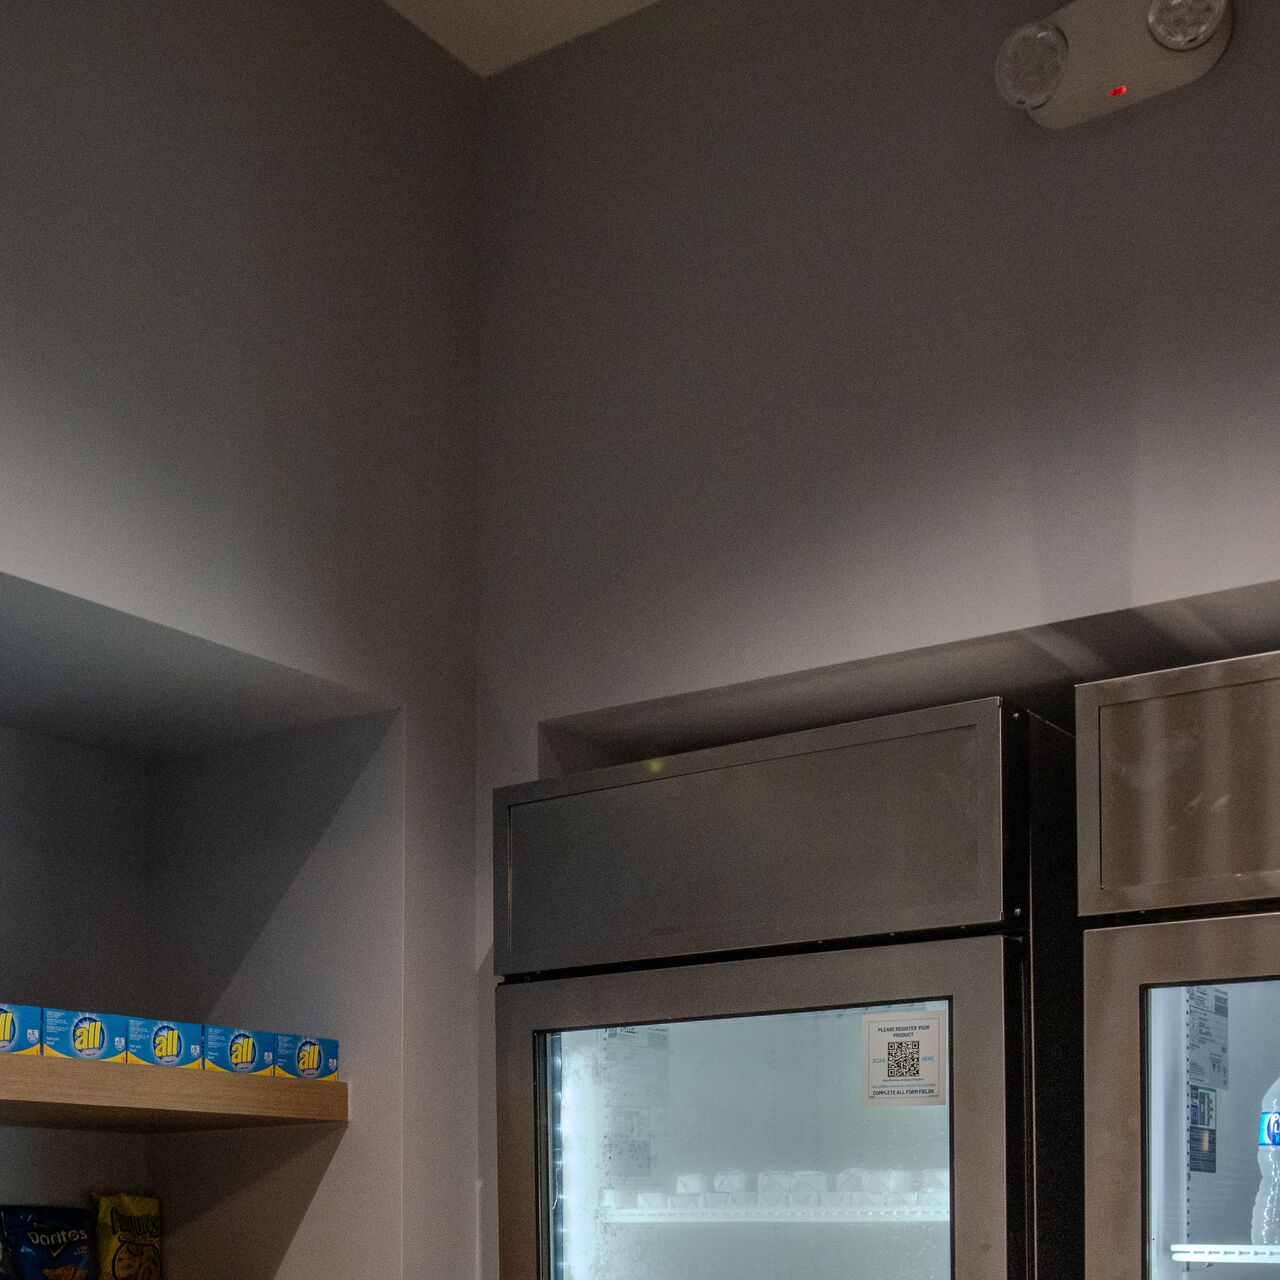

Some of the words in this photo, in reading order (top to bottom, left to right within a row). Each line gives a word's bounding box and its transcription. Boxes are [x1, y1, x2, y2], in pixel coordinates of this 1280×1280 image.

[73, 1021, 102, 1050] all
[154, 1029, 179, 1057] all
[230, 1037, 254, 1064] all
[296, 1043, 320, 1070] all
[26, 1227, 88, 1248] Doritos
